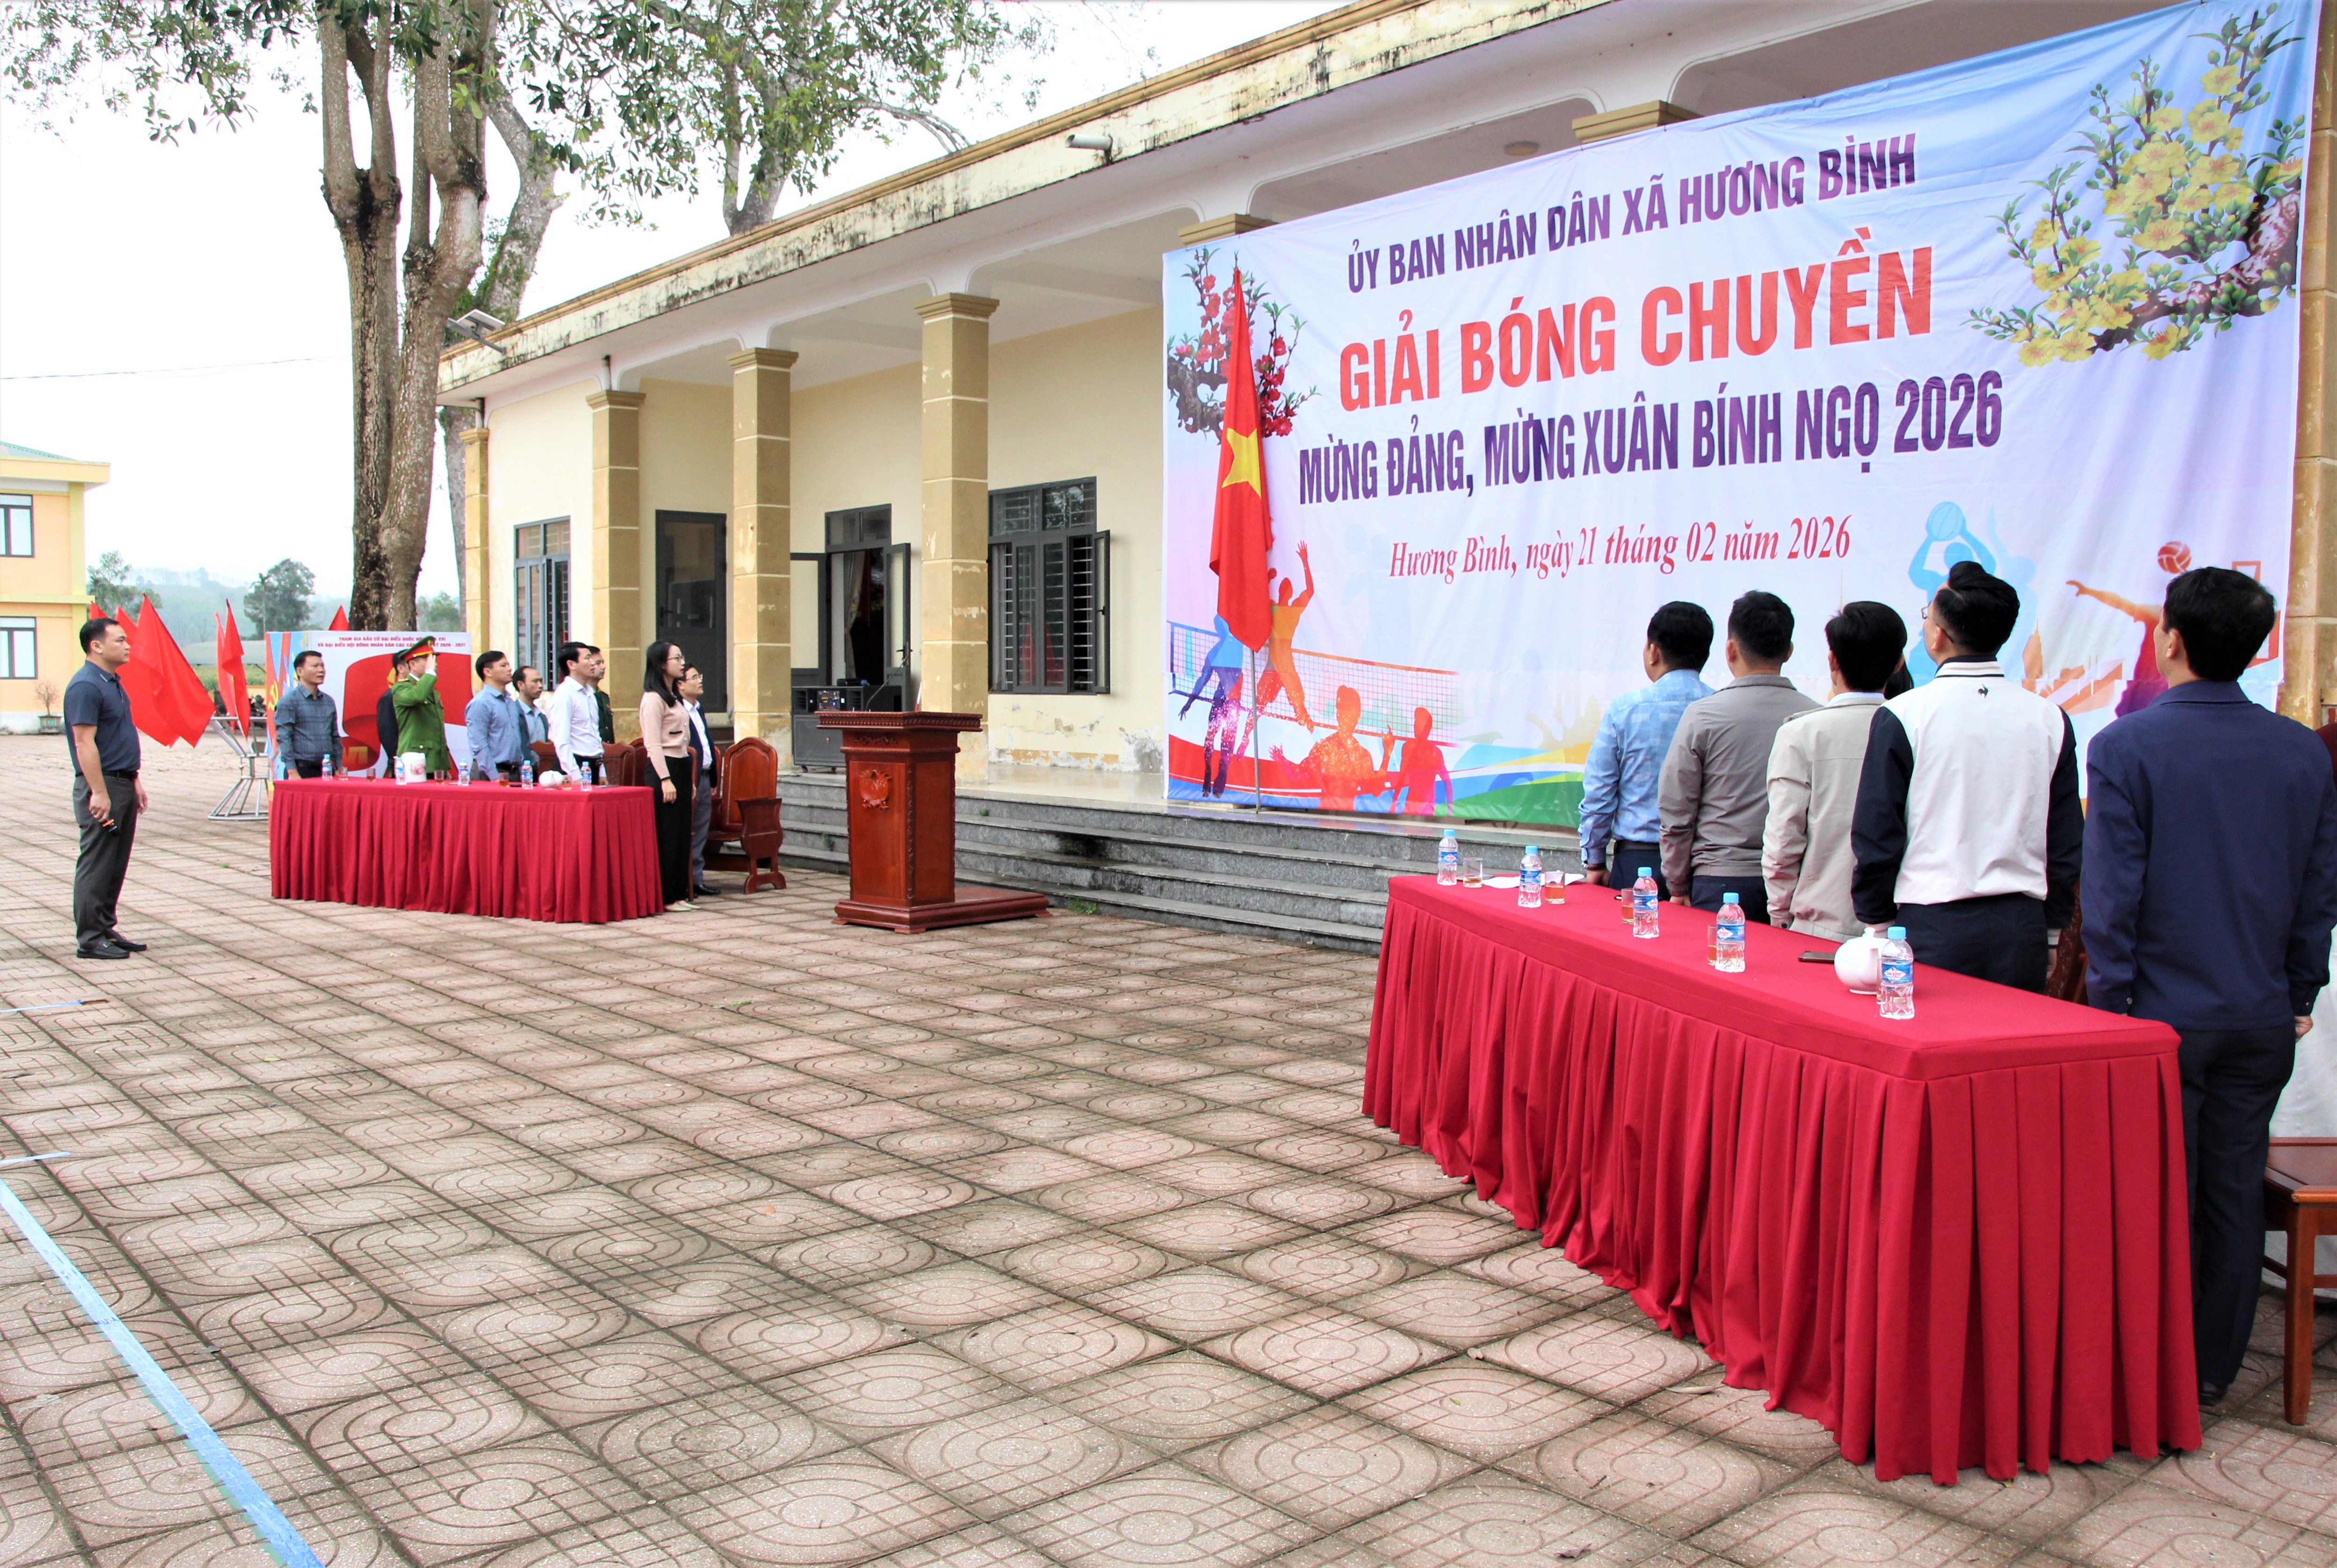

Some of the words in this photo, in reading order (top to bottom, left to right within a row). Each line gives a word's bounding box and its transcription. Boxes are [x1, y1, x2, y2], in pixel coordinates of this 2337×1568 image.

[1348, 238, 1379, 293] ỦY
[1390, 235, 1444, 285] BAN
[1455, 209, 1537, 271] NHÂN
[1548, 191, 1610, 251] DÂN
[1622, 175, 1668, 235] XÃ
[1680, 156, 1804, 225] HƯƠNG
[1819, 134, 1915, 200] BÌNH
[1340, 309, 1439, 411] GIẢI
[1460, 297, 1615, 394] BÓNG
[1641, 227, 1932, 366] CHUYỀN
[1299, 434, 1377, 505] MỪNG
[1386, 415, 1472, 497] ĐẢNG,
[1484, 408, 1574, 486] MỪNG
[1583, 392, 1678, 476] XUÂN
[1693, 382, 1781, 468] BÍNH
[1795, 386, 1878, 473] NGỌ
[1894, 371, 2002, 453] 2026
[1390, 542, 1458, 584] Hương
[1462, 535, 1517, 577] Bình,
[1526, 530, 1574, 580] ngày
[1578, 527, 1597, 566] 21
[1605, 524, 1679, 574] tháng
[1686, 521, 1716, 562] 02
[1724, 521, 1779, 561] năm
[1787, 515, 1851, 559] 2026
